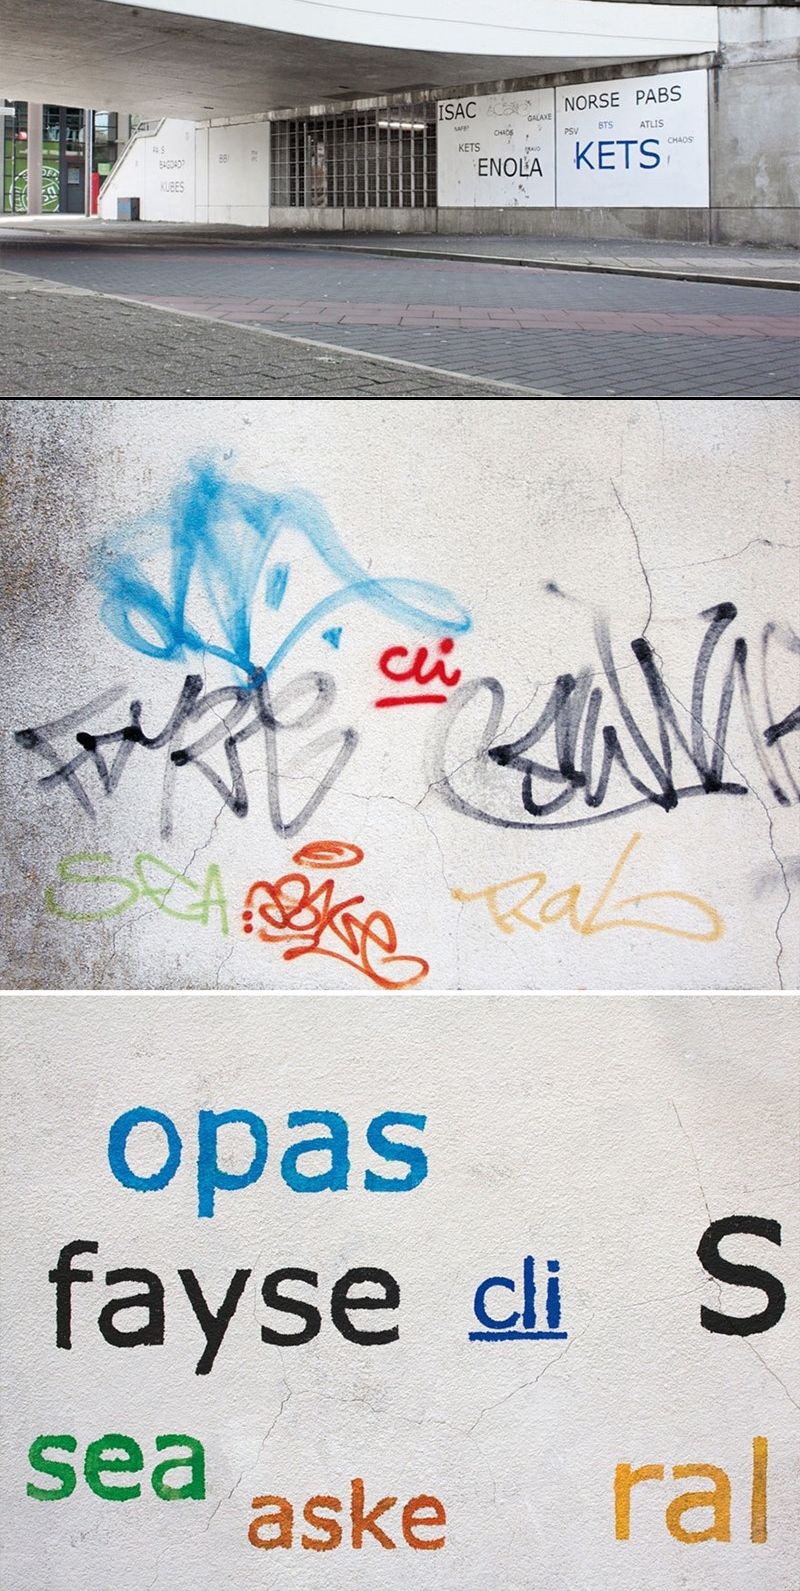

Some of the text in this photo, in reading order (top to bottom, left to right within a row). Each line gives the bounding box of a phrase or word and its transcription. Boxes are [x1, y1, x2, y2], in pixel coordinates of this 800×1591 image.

[438, 102, 477, 121] ISAC
[527, 113, 552, 122] GALAXE
[564, 85, 682, 112] NORSE PABS
[458, 143, 481, 153] KETS
[478, 158, 543, 177] ENOLA
[575, 138, 661, 170] KETS
[107, 1106, 428, 1218] opas
[48, 1240, 400, 1376] fayse
[468, 1255, 568, 1341] cli
[696, 1215, 786, 1337] S
[26, 1433, 206, 1501] sea
[613, 1436, 768, 1544] ral
[247, 1478, 446, 1550] aske
